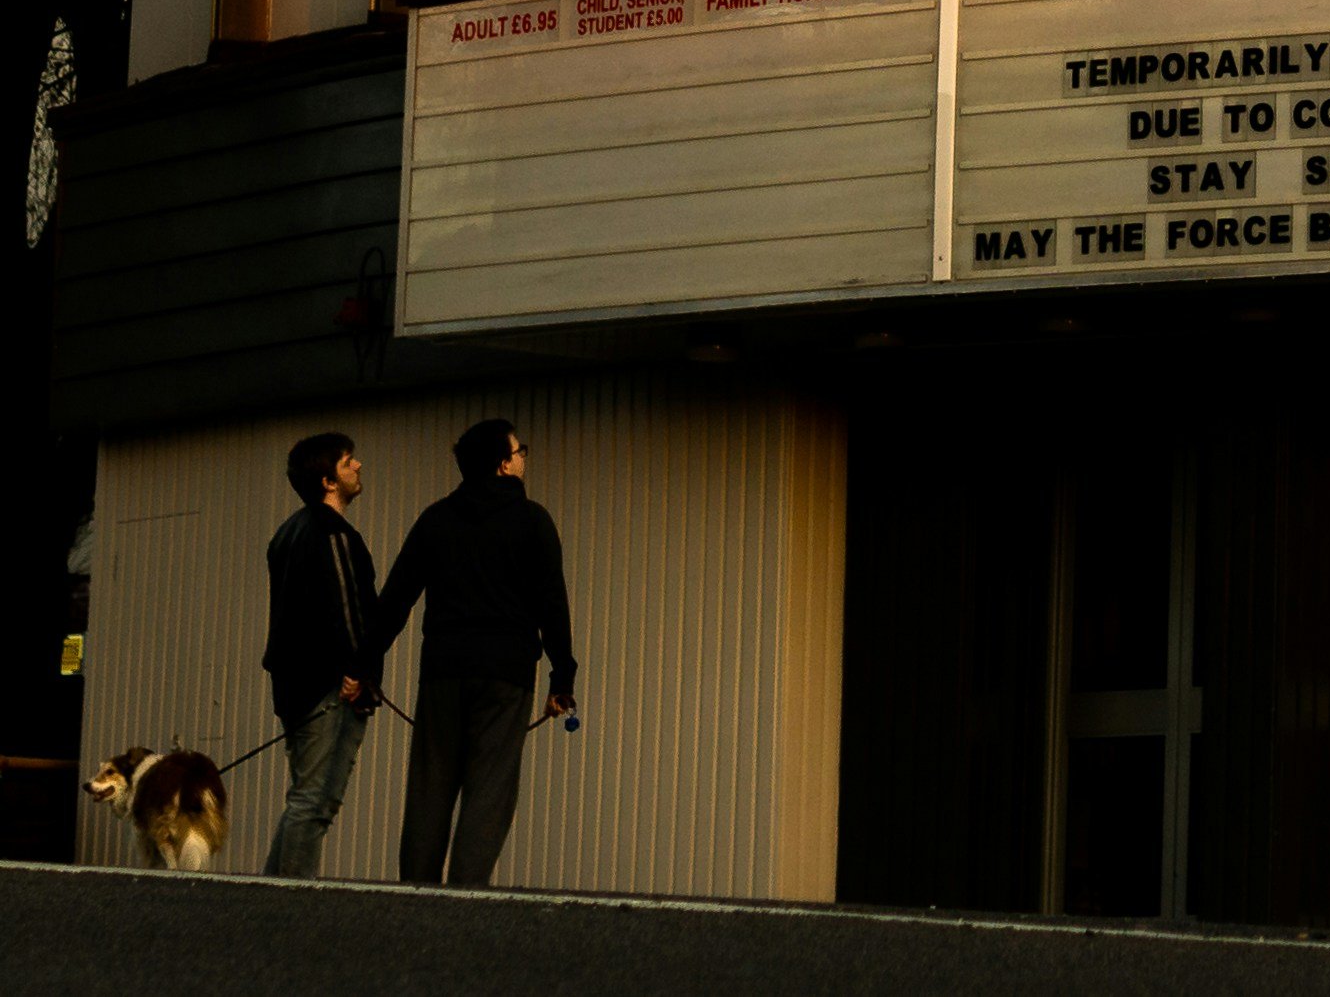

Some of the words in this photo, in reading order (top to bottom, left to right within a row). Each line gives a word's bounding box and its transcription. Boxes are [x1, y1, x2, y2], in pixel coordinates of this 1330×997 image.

[451, 16, 508, 43] ADULT
[511, 9, 557, 35] £6.95
[577, 12, 644, 36] STUDENT
[646, 6, 683, 27] £5.00
[1066, 41, 1330, 89] TEMPORARILY
[1129, 107, 1201, 141] DUE
[1224, 102, 1275, 134] TO
[1149, 159, 1253, 196] STAY
[974, 227, 1054, 261] MAY
[1075, 222, 1145, 255] THE
[1167, 213, 1291, 250] FORCE
